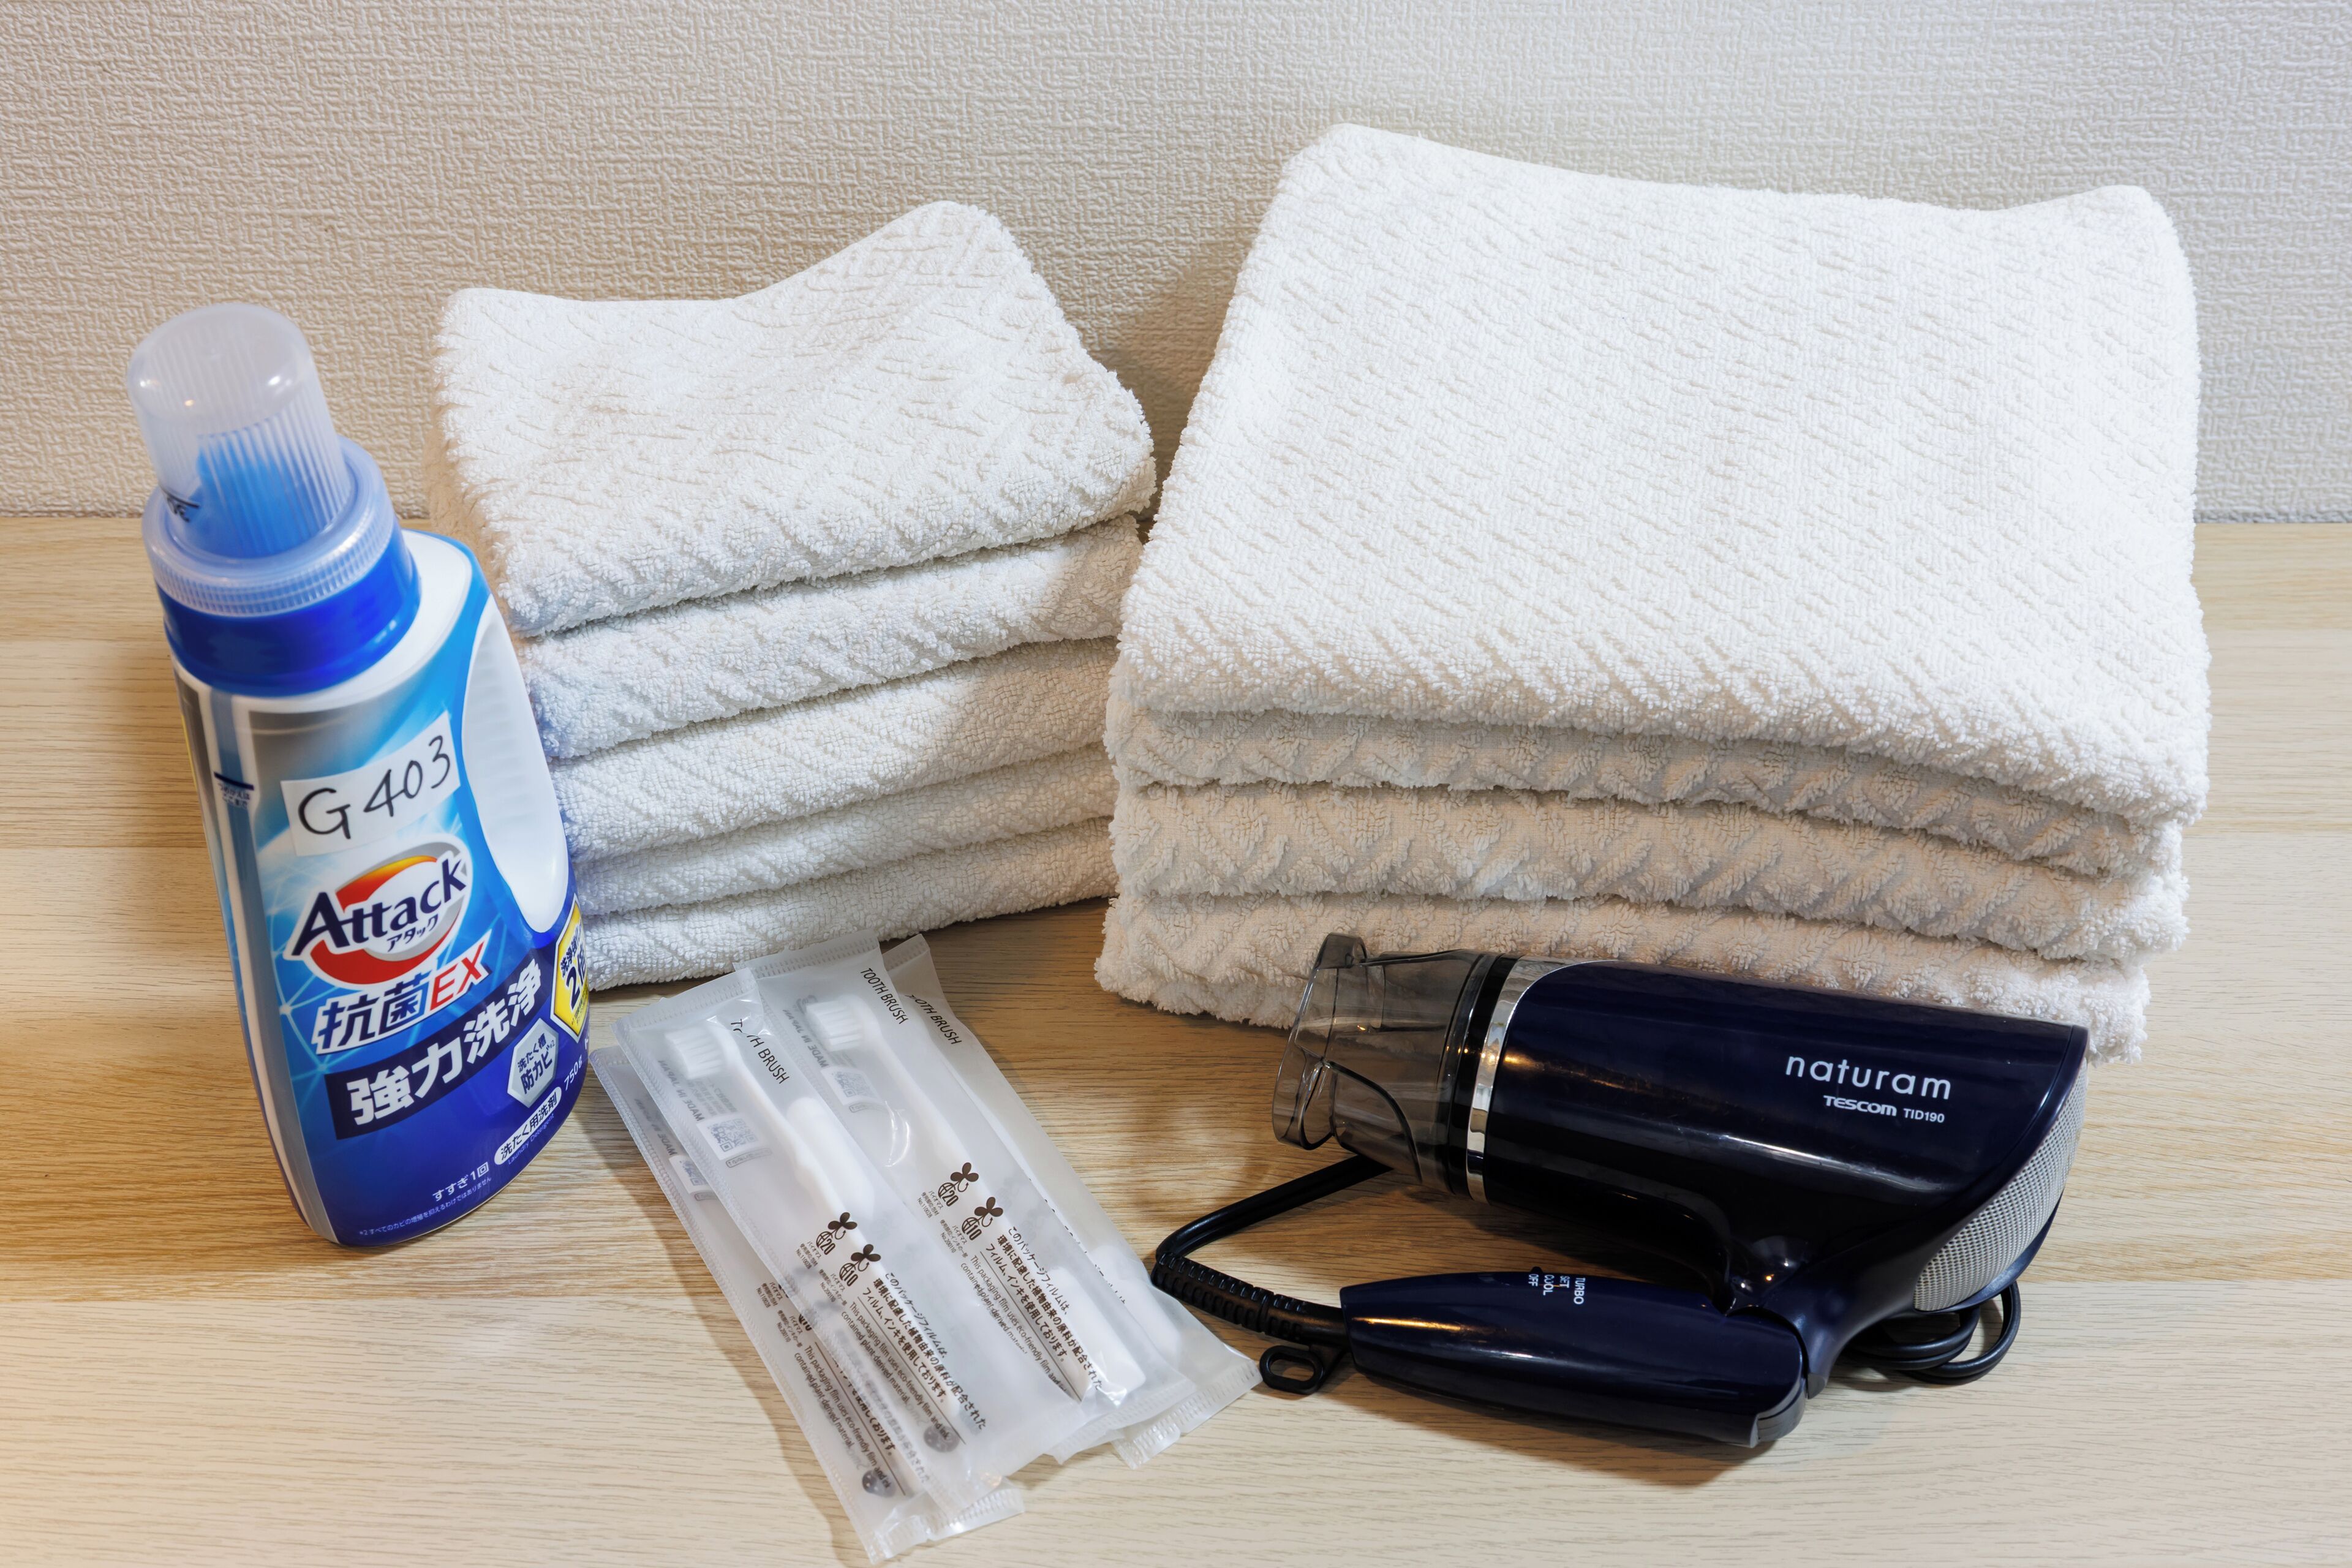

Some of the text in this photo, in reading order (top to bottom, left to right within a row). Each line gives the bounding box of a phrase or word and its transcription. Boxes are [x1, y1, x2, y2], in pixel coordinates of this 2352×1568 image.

[298, 735, 450, 839] G 403
[291, 858, 467, 956] Attack
[386, 913, 439, 952] アタック
[861, 968, 908, 1024] TOOTH BRUSH
[347, 959, 541, 1126] 強力洗浄
[931, 1016, 962, 1044] BRUSH
[758, 1049, 790, 1084] BRUSH
[1785, 1056, 1951, 1099] naturam
[500, 1092, 557, 1161] 洗たく用洗剤
[1903, 1108, 1945, 1123] TID190
[508, 1142, 530, 1165] Laundry
[942, 1189, 959, 1207] 20
[820, 1238, 835, 1255] 20
[967, 1225, 982, 1240] 10
[844, 1270, 858, 1286] 10
[960, 1263, 984, 1292] contained
[1008, 1226, 1071, 1315] このパッケージフィルムは、
[1528, 1273, 1539, 1287] OFF
[1543, 1275, 1555, 1296] COOL
[1559, 1276, 1570, 1288] SET
[986, 1243, 1068, 1362] フィルム、インキを使用しております。
[1574, 1278, 1586, 1305] TURBO
[970, 1255, 981, 1270] This
[977, 1268, 1001, 1300] packaging
[998, 1298, 1009, 1313] film
[1007, 1311, 1019, 1326] uses
[1017, 1325, 1042, 1361] eco-friendly
[1040, 1360, 1051, 1374] film
[841, 1311, 865, 1341] contained
[861, 1340, 893, 1379] plant-derived
[850, 1301, 860, 1316] This
[857, 1315, 881, 1346] packaging
[880, 1343, 889, 1357] film
[888, 1356, 900, 1371] uses
[897, 1369, 924, 1405] eco-friendly
[922, 1402, 932, 1417] film
[862, 1287, 947, 1403] フィルム、インキを使用しております。
[794, 1352, 816, 1383] contained
[809, 1383, 840, 1422] plant-derived
[804, 1345, 815, 1360] This
[810, 1359, 833, 1392] packaging
[829, 1389, 840, 1403] film
[837, 1403, 848, 1417] uses
[845, 1417, 870, 1452] eco-friendly
[867, 1452, 877, 1466] film
